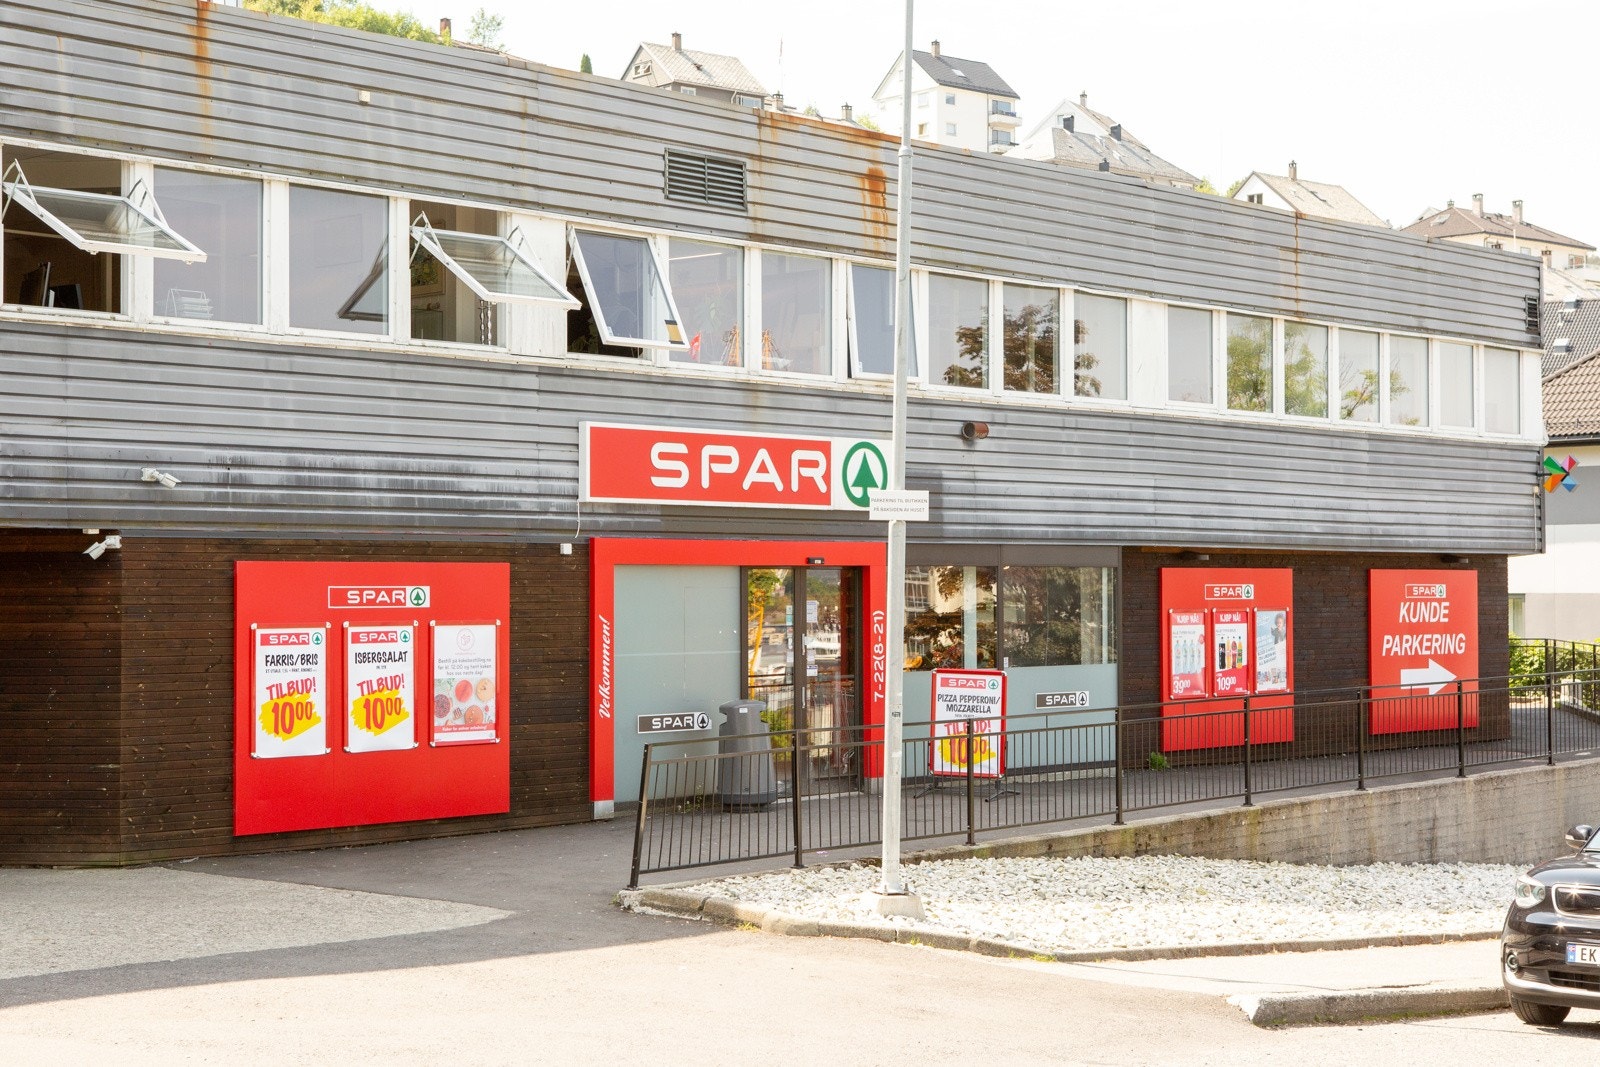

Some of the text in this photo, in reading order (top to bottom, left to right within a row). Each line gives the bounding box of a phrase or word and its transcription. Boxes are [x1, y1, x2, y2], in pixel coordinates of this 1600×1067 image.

[650, 442, 828, 494] SPAR
[347, 590, 405, 604] SPAR
[1213, 587, 1242, 597] SPAR
[1412, 587, 1436, 595] SPAR
[1399, 602, 1449, 623] KUNDE
[269, 634, 309, 644] SPAR
[359, 633, 397, 642] SPAR
[1382, 633, 1466, 656] PARKERING
[265, 654, 318, 666] FARRIS/BRIS
[354, 651, 408, 664] ISBERGSALAT
[873, 610, 885, 702] 7-22(8-21)
[597, 614, 612, 719] Velkommen!
[266, 677, 317, 701] TILBUD!
[357, 673, 405, 697] TILBUD!
[948, 679, 986, 688] SPAR
[937, 694, 1001, 704] PIZZA PEPPERONI/
[1045, 695, 1076, 705] SPAR
[363, 697, 402, 731] 1000
[946, 704, 991, 714] MOZZARELLA
[272, 701, 313, 735] 1000
[651, 716, 694, 728] SPAR
[1580, 948, 1596, 962] EK
